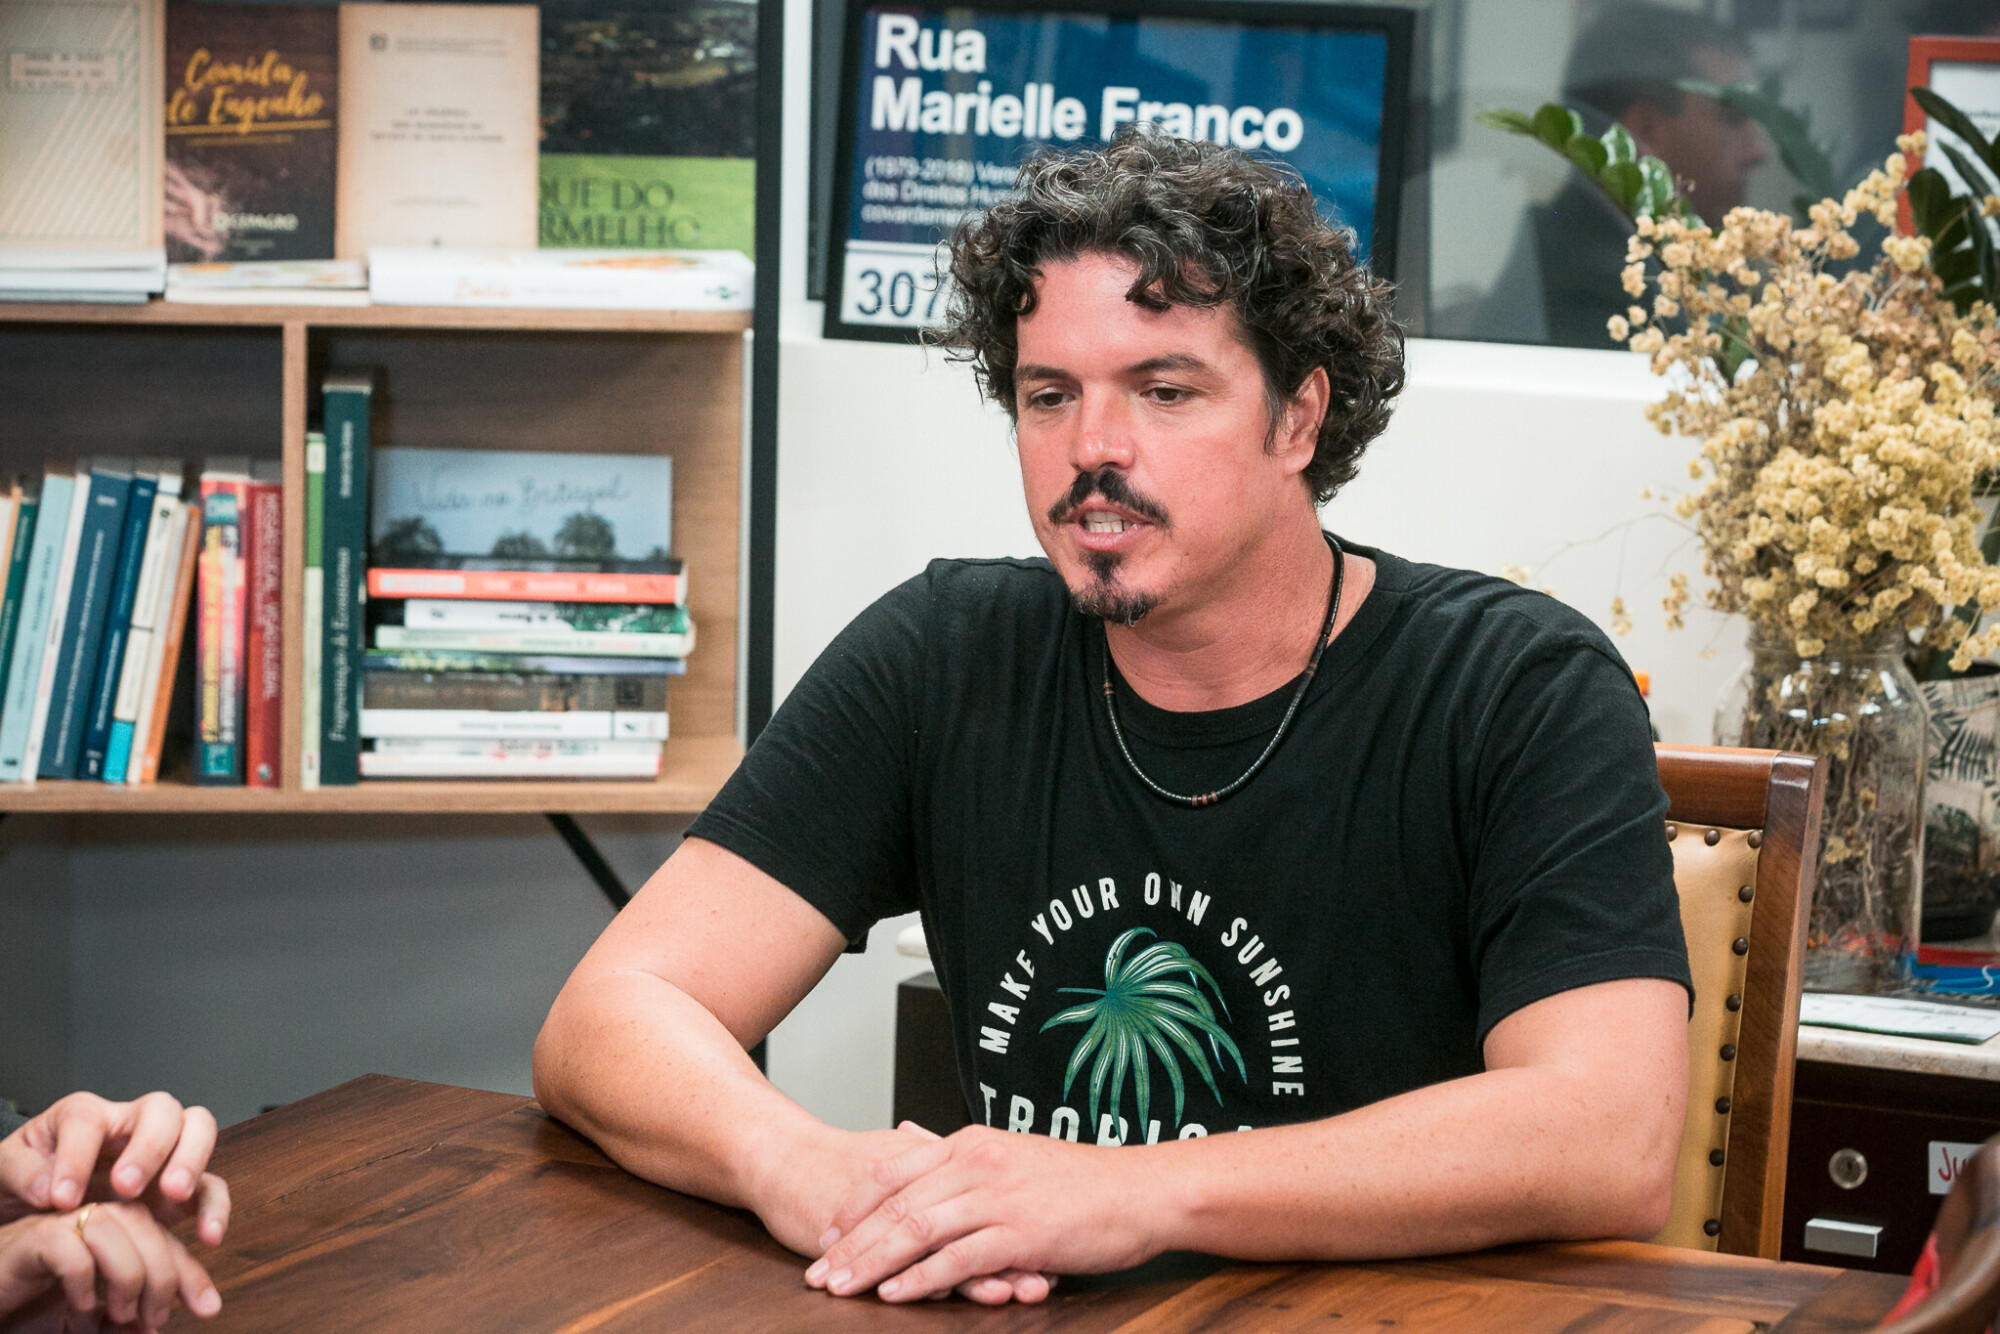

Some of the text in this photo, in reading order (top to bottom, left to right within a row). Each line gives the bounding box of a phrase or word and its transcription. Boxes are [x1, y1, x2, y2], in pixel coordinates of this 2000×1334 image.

[185, 48, 292, 91] Comida
[875, 14, 987, 73] Rua
[208, 70, 324, 134] Engenho
[870, 76, 1304, 152] Marielle Franco
[612, 178, 674, 210] DO
[979, 949, 1035, 1054] MAKE
[1031, 877, 1120, 945] YOUR
[1220, 917, 1304, 1096] SUNSHINE
